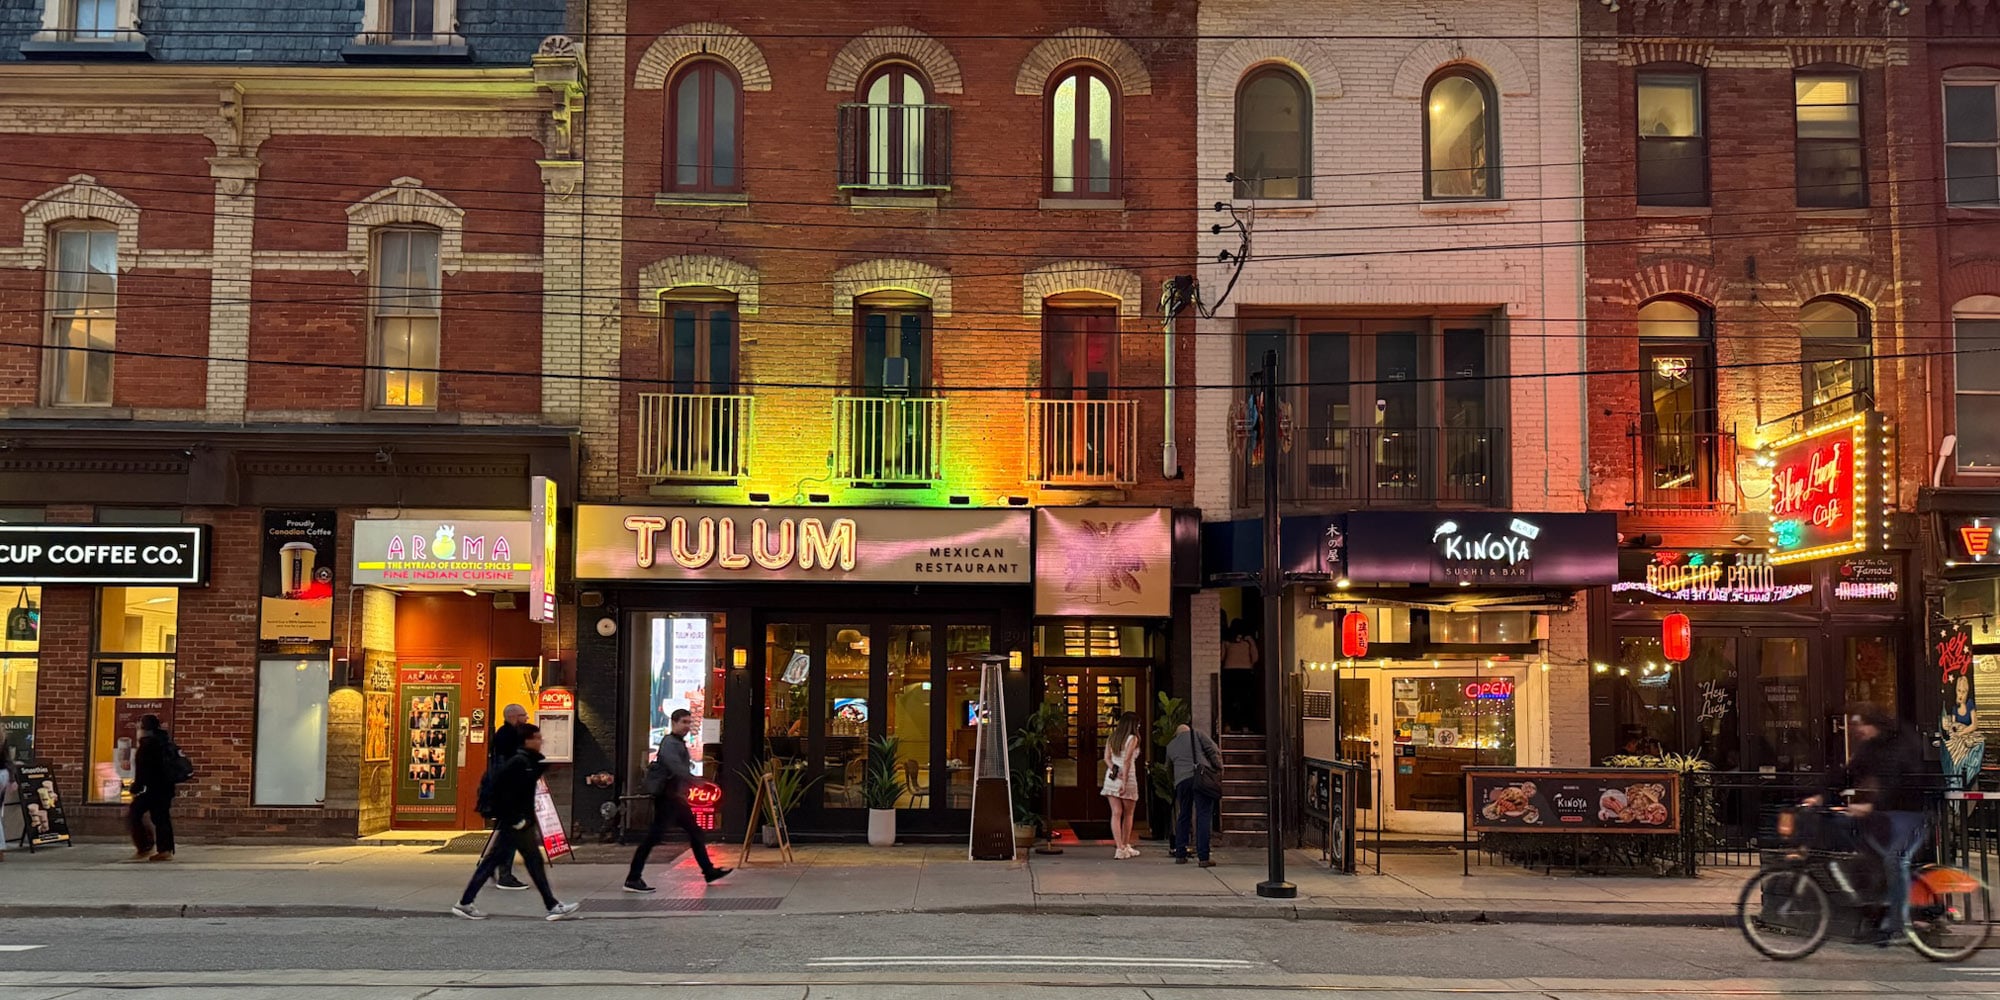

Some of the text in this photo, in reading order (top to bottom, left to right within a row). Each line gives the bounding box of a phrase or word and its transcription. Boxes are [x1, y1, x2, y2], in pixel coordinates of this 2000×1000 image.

[1774, 467, 1804, 514] Hey
[286, 520, 315, 528] Proudly
[546, 486, 556, 592] ARMA
[624, 515, 857, 571] TULUM
[1326, 523, 1340, 562] 木の屋
[0, 545, 42, 563] CUP
[48, 545, 137, 564] COFFEE
[930, 547, 1004, 558] MEXICAN
[1446, 533, 1529, 565] KINOYA
[387, 562, 402, 570] THE
[404, 562, 436, 570] MYRIAD
[438, 562, 449, 570] OF
[451, 562, 482, 570] EXOTIC
[915, 562, 1019, 574] RESTAURANT
[1446, 568, 1525, 576] SUSHI & BAR
[1853, 566, 1893, 577] Famous
[383, 571, 514, 580] FINE INDIAN CUISINE
[1646, 564, 1722, 593] ROOFTOP
[1727, 565, 1775, 592] PATIO
[1936, 631, 1967, 667] Hey
[1943, 654, 1971, 684] Lucy
[1465, 682, 1513, 698] OPEN
[542, 694, 571, 703] AROMA
[1558, 797, 1588, 809] KINOYA
